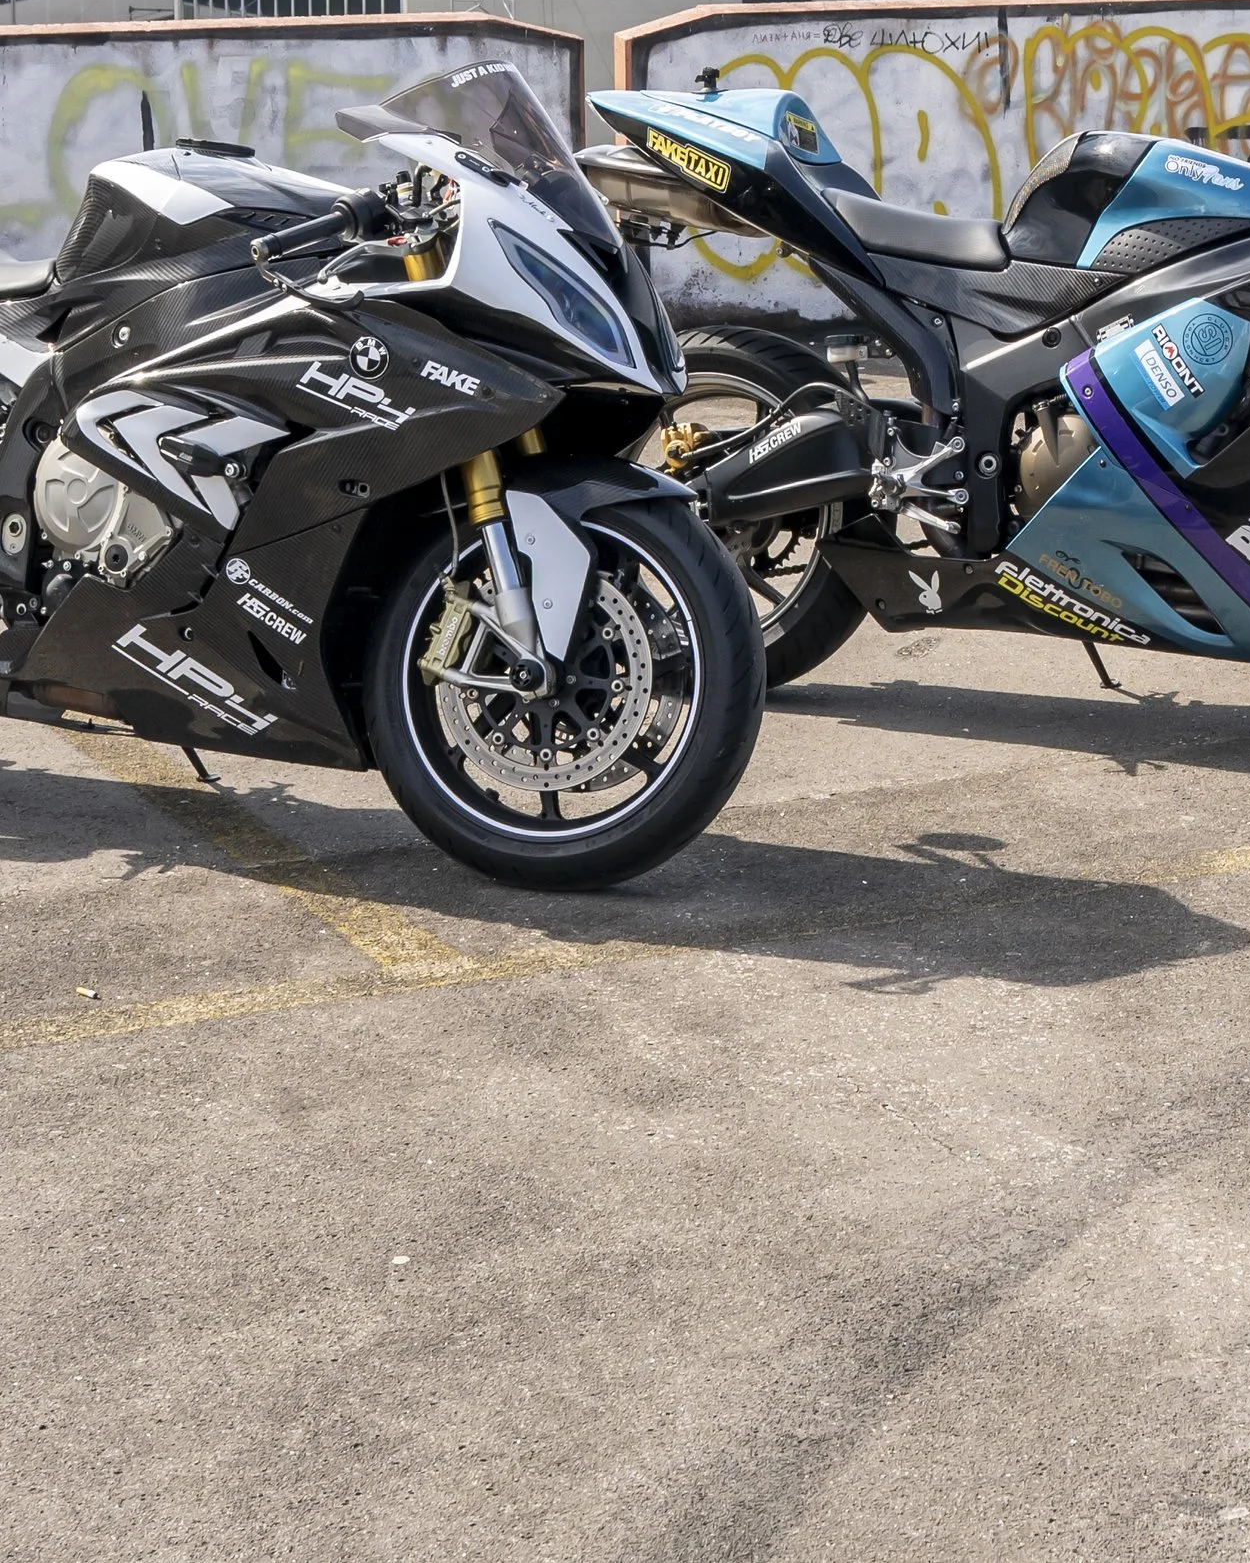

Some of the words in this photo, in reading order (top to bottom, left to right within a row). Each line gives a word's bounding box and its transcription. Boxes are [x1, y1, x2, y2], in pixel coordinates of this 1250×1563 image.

[451, 68, 478, 88] JUST
[477, 66, 488, 76] A
[486, 63, 506, 74] KID
[649, 130, 687, 165] FAKE
[687, 149, 725, 186] TAXI
[420, 360, 481, 396] FAKE
[1146, 356, 1177, 398] DENSO
[351, 405, 400, 431] RACE
[248, 578, 314, 625] CARBON.com
[998, 573, 1125, 642] Discount
[437, 616, 458, 657] brembo
[187, 693, 259, 736] RACE
